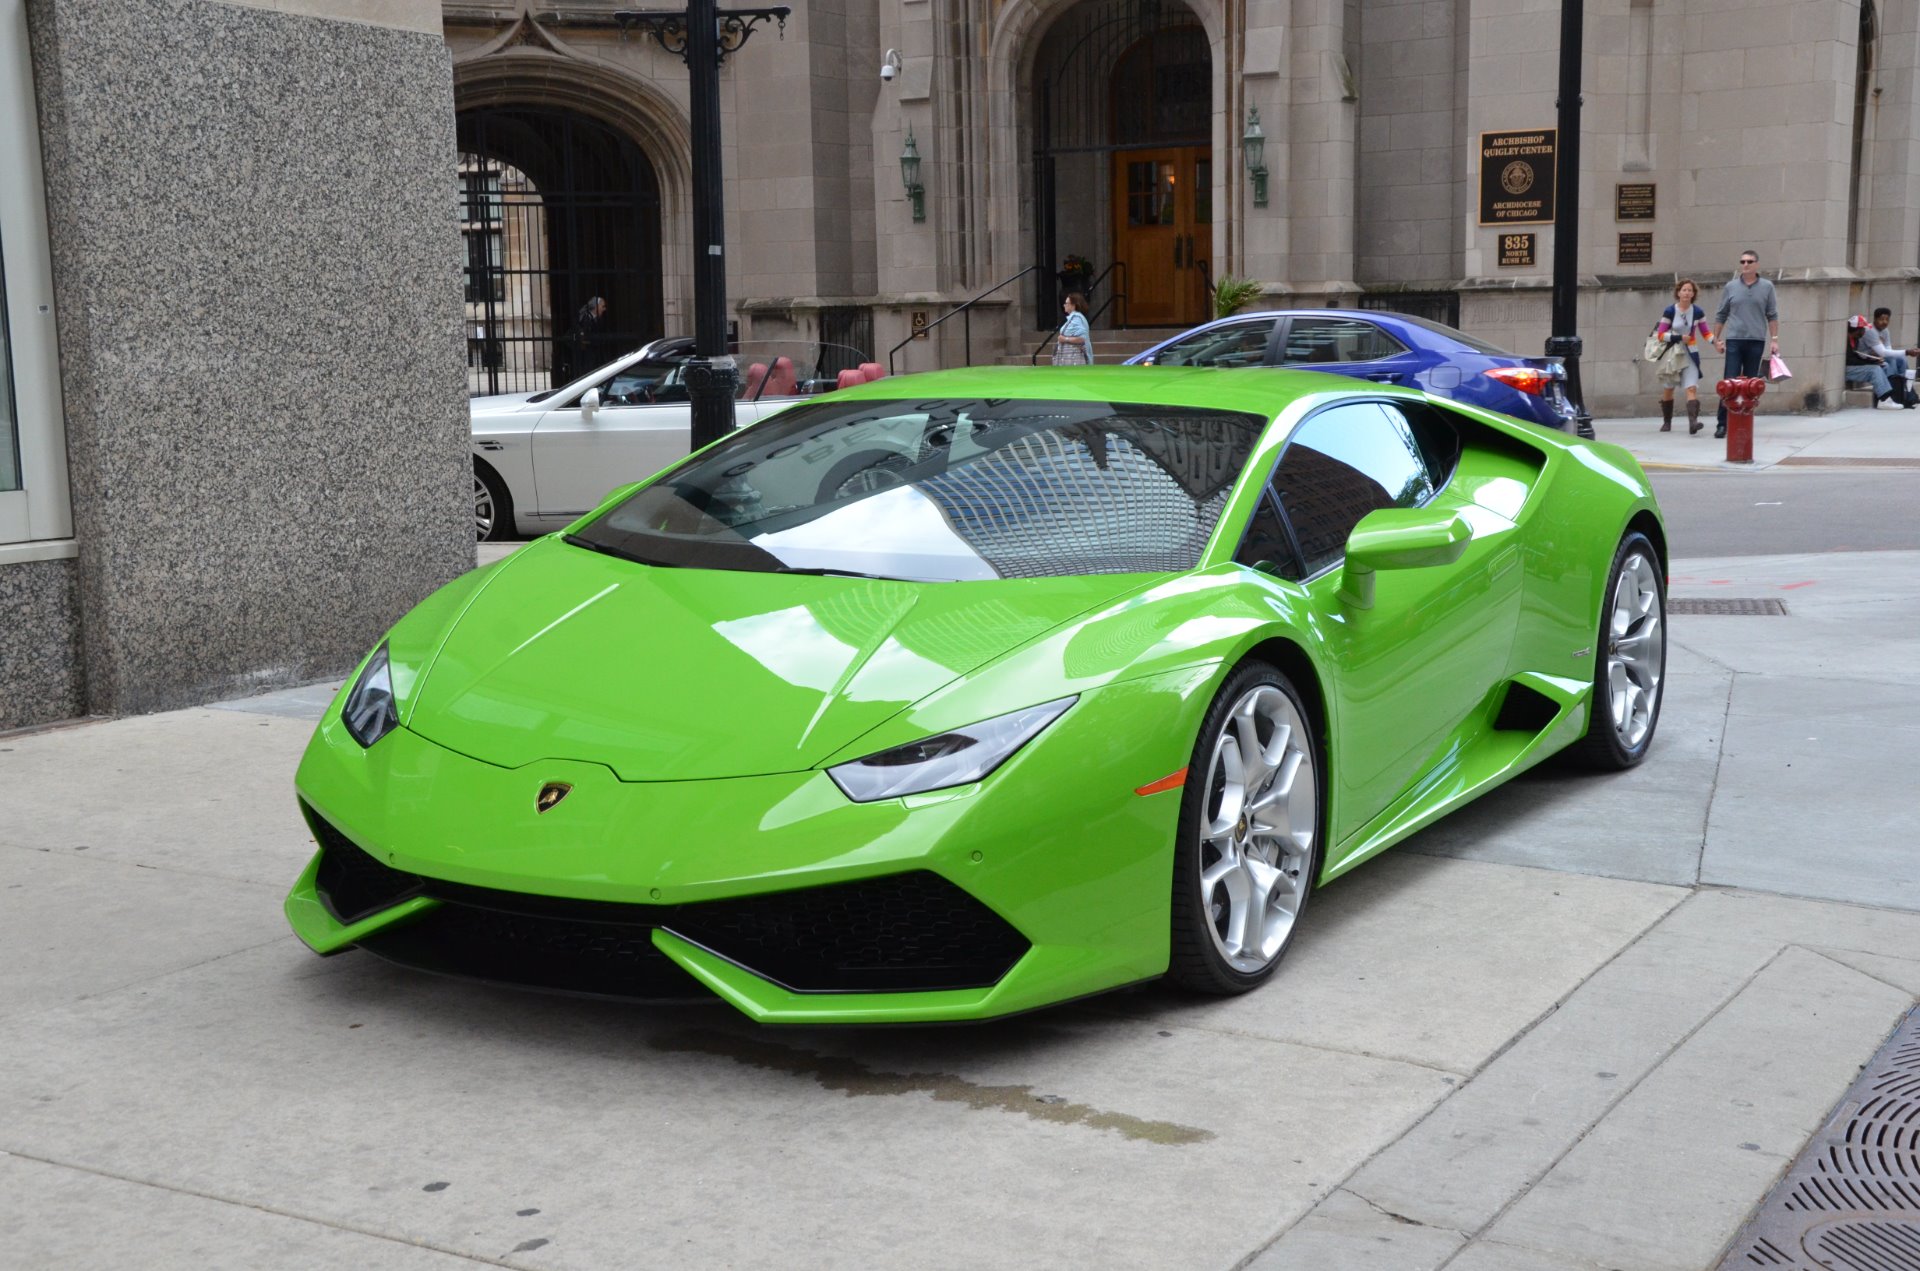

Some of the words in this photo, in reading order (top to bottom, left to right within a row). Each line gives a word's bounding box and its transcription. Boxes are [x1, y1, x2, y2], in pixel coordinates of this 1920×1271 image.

[1492, 136, 1544, 146] ARCHBISHOP
[1484, 147, 1519, 157] QUIGLEY
[1520, 145, 1553, 154] CENTER
[1492, 201, 1541, 209] ARCHDIOCESE
[1506, 209, 1538, 217] CHICAGO
[1505, 235, 1529, 250] 835
[1502, 257, 1520, 265] RUSH
